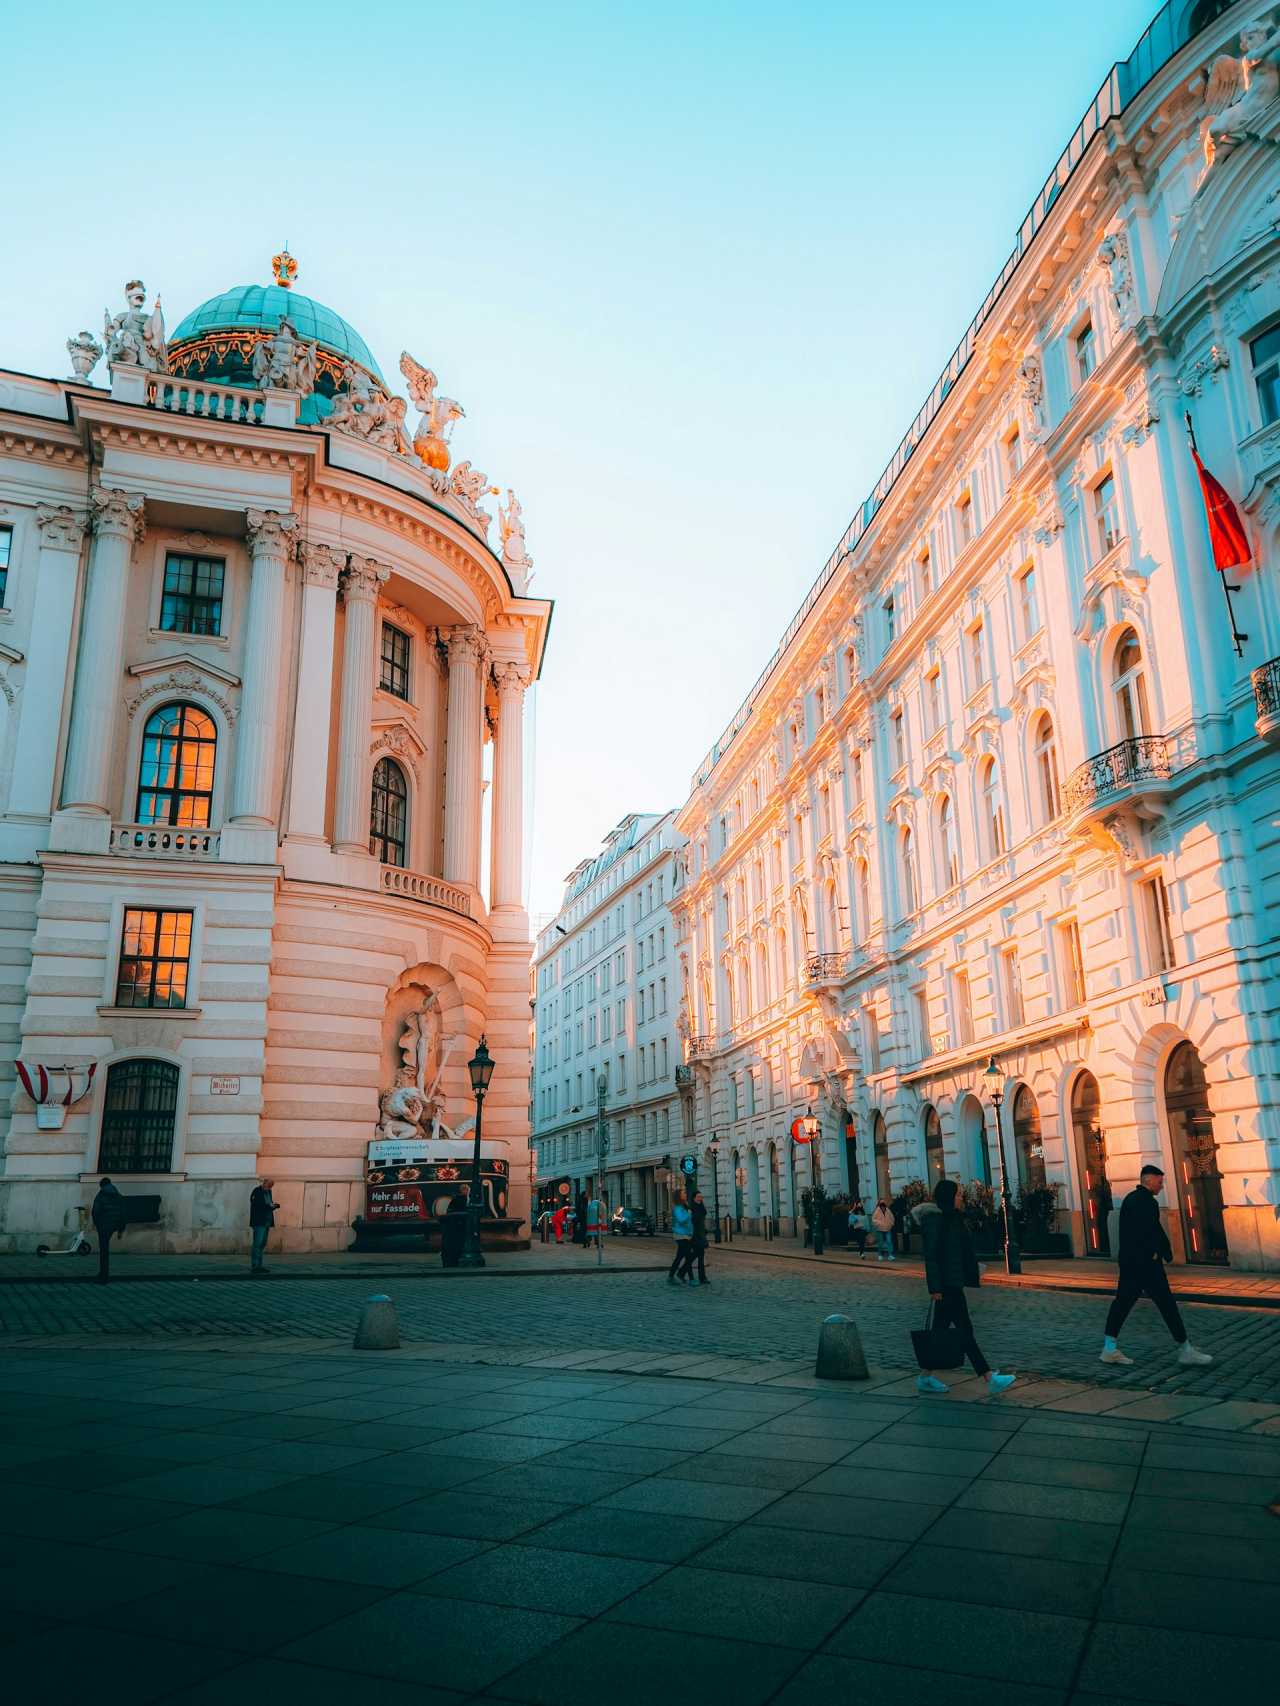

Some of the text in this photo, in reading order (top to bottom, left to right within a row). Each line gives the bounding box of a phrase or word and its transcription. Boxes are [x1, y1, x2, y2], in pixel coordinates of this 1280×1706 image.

[372, 1190, 405, 1201] Mehr als
[371, 1202, 420, 1214] nur Fassade
